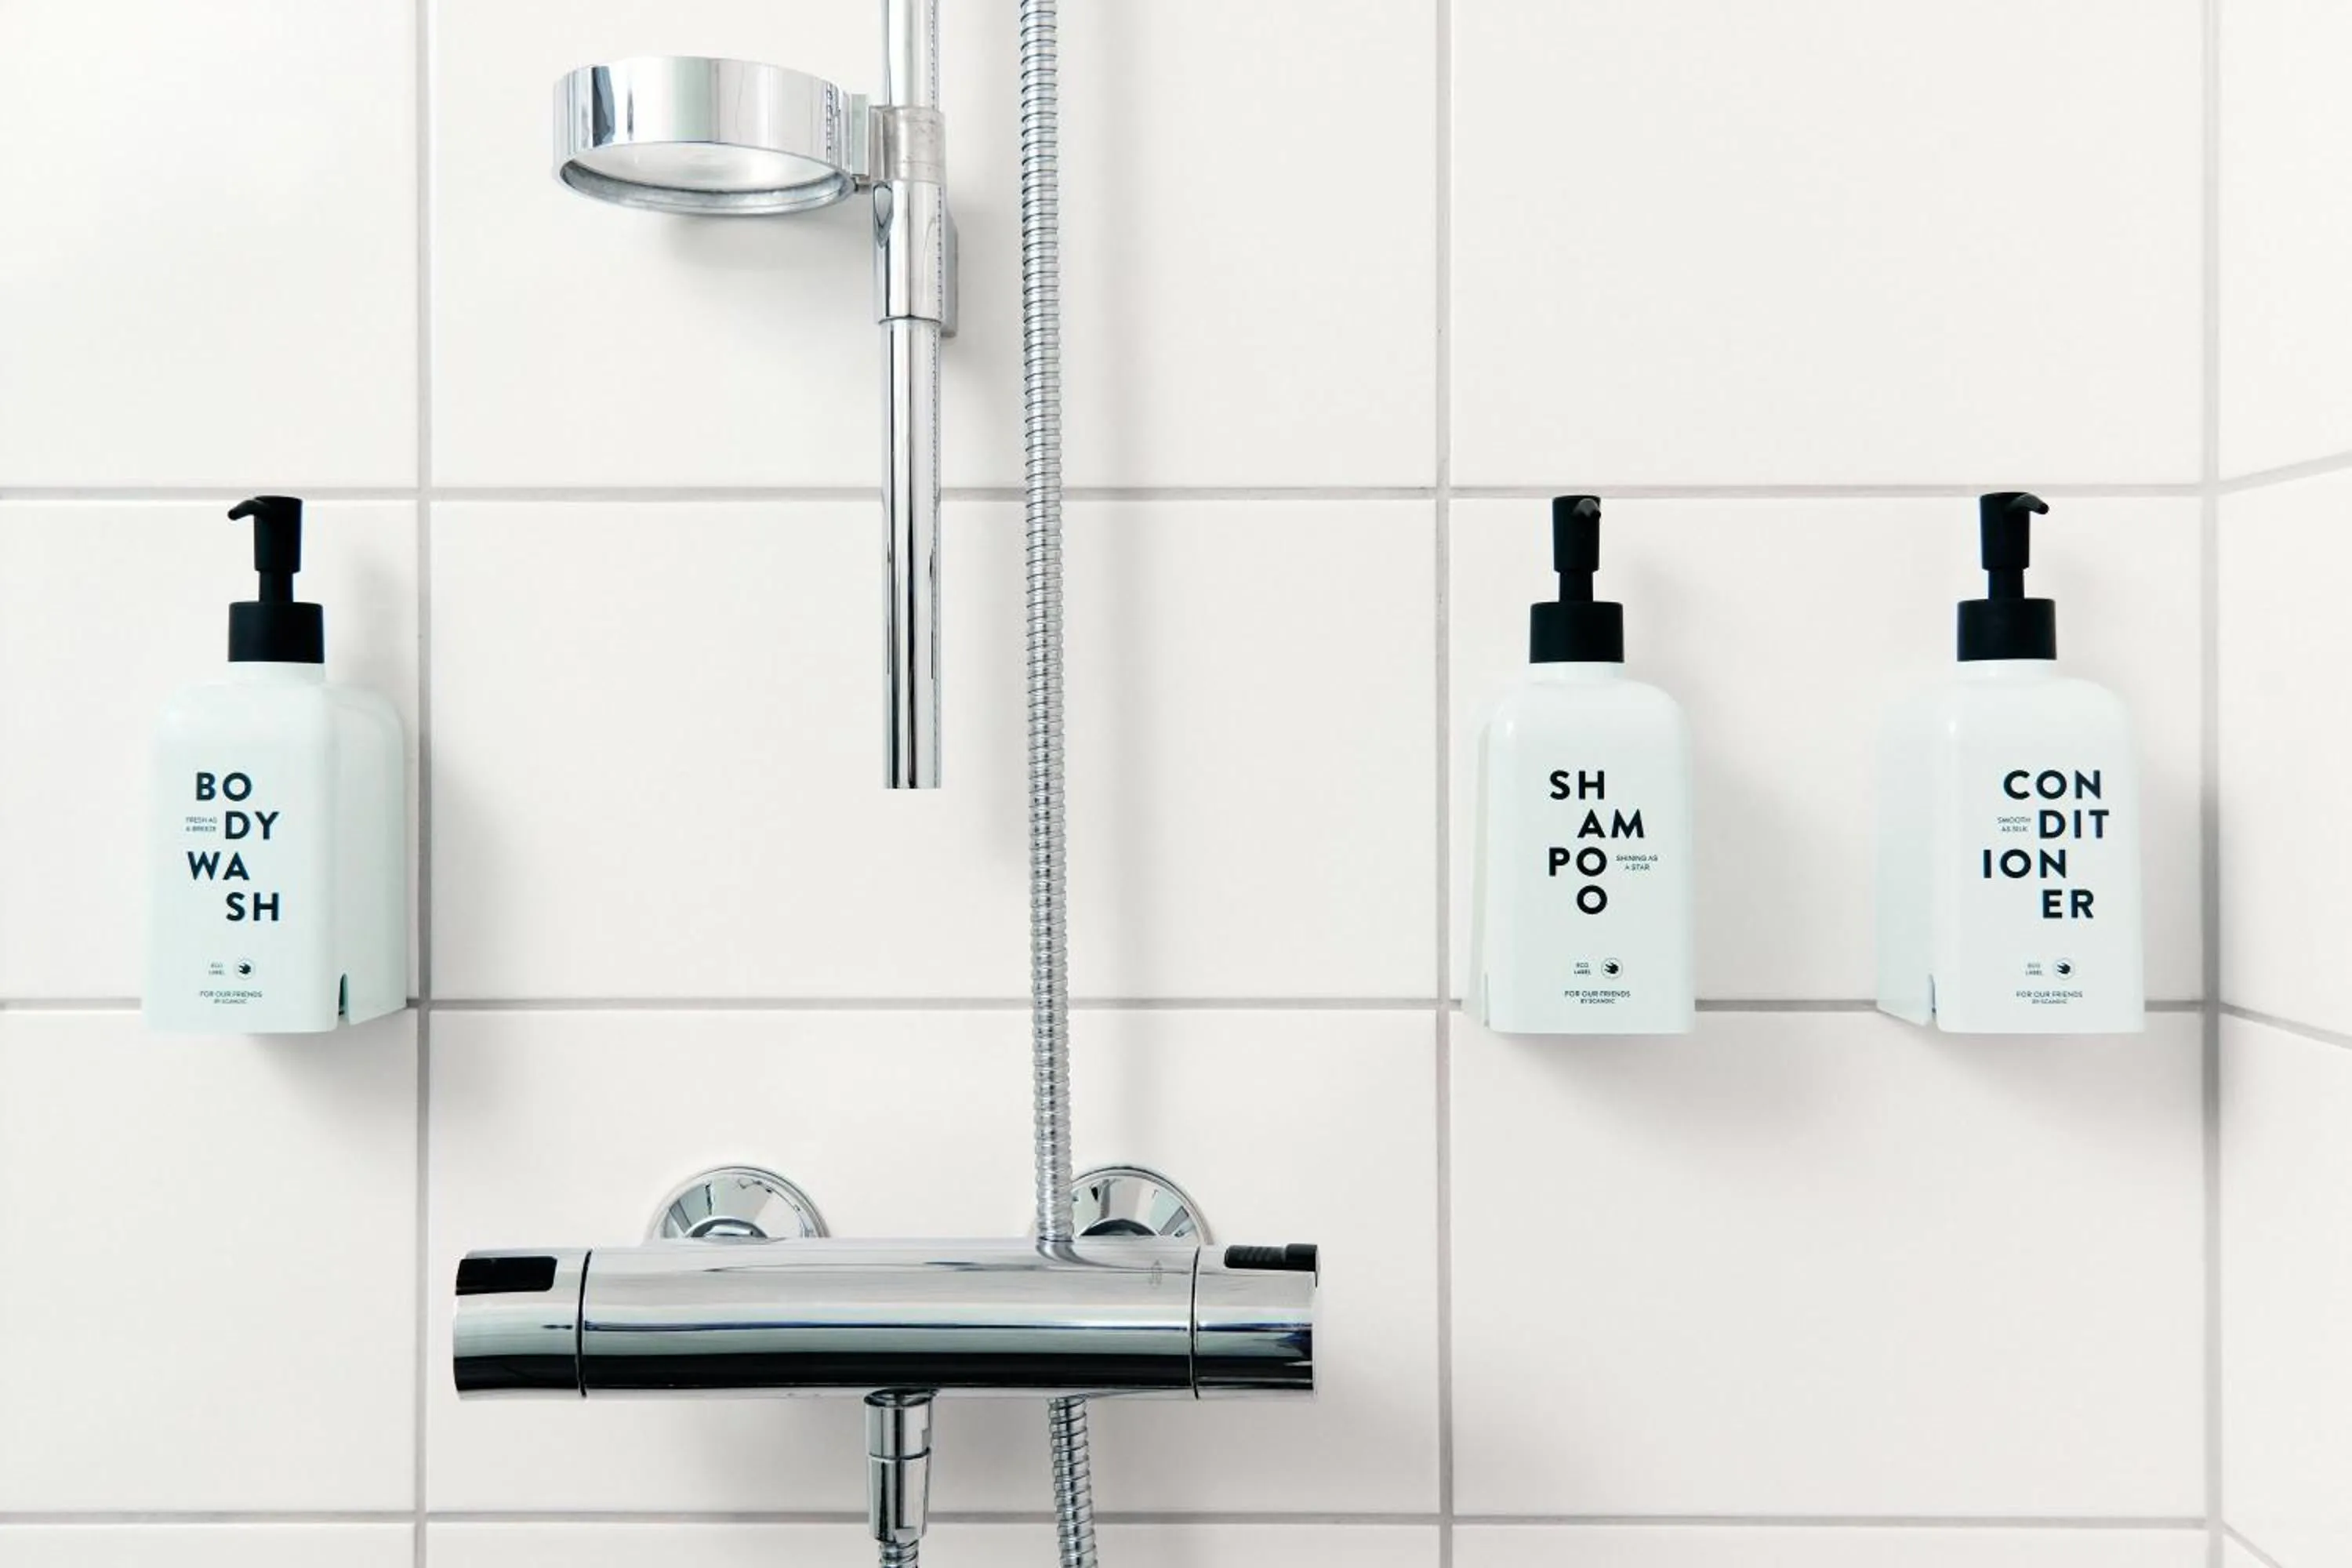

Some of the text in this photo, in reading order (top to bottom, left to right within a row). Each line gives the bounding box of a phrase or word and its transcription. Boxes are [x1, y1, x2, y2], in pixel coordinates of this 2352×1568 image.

[196, 771, 252, 801] BO
[1549, 770, 1605, 800] SH
[2003, 770, 2101, 800] CON
[225, 811, 280, 840] DY
[1577, 808, 1645, 838] AM
[2040, 810, 2109, 838] DIT
[187, 851, 250, 880] WA
[1549, 847, 1607, 877] PO
[1983, 849, 2067, 878] ION
[226, 892, 280, 921] SH
[1577, 884, 1607, 915] O
[2042, 889, 2094, 918] ER
